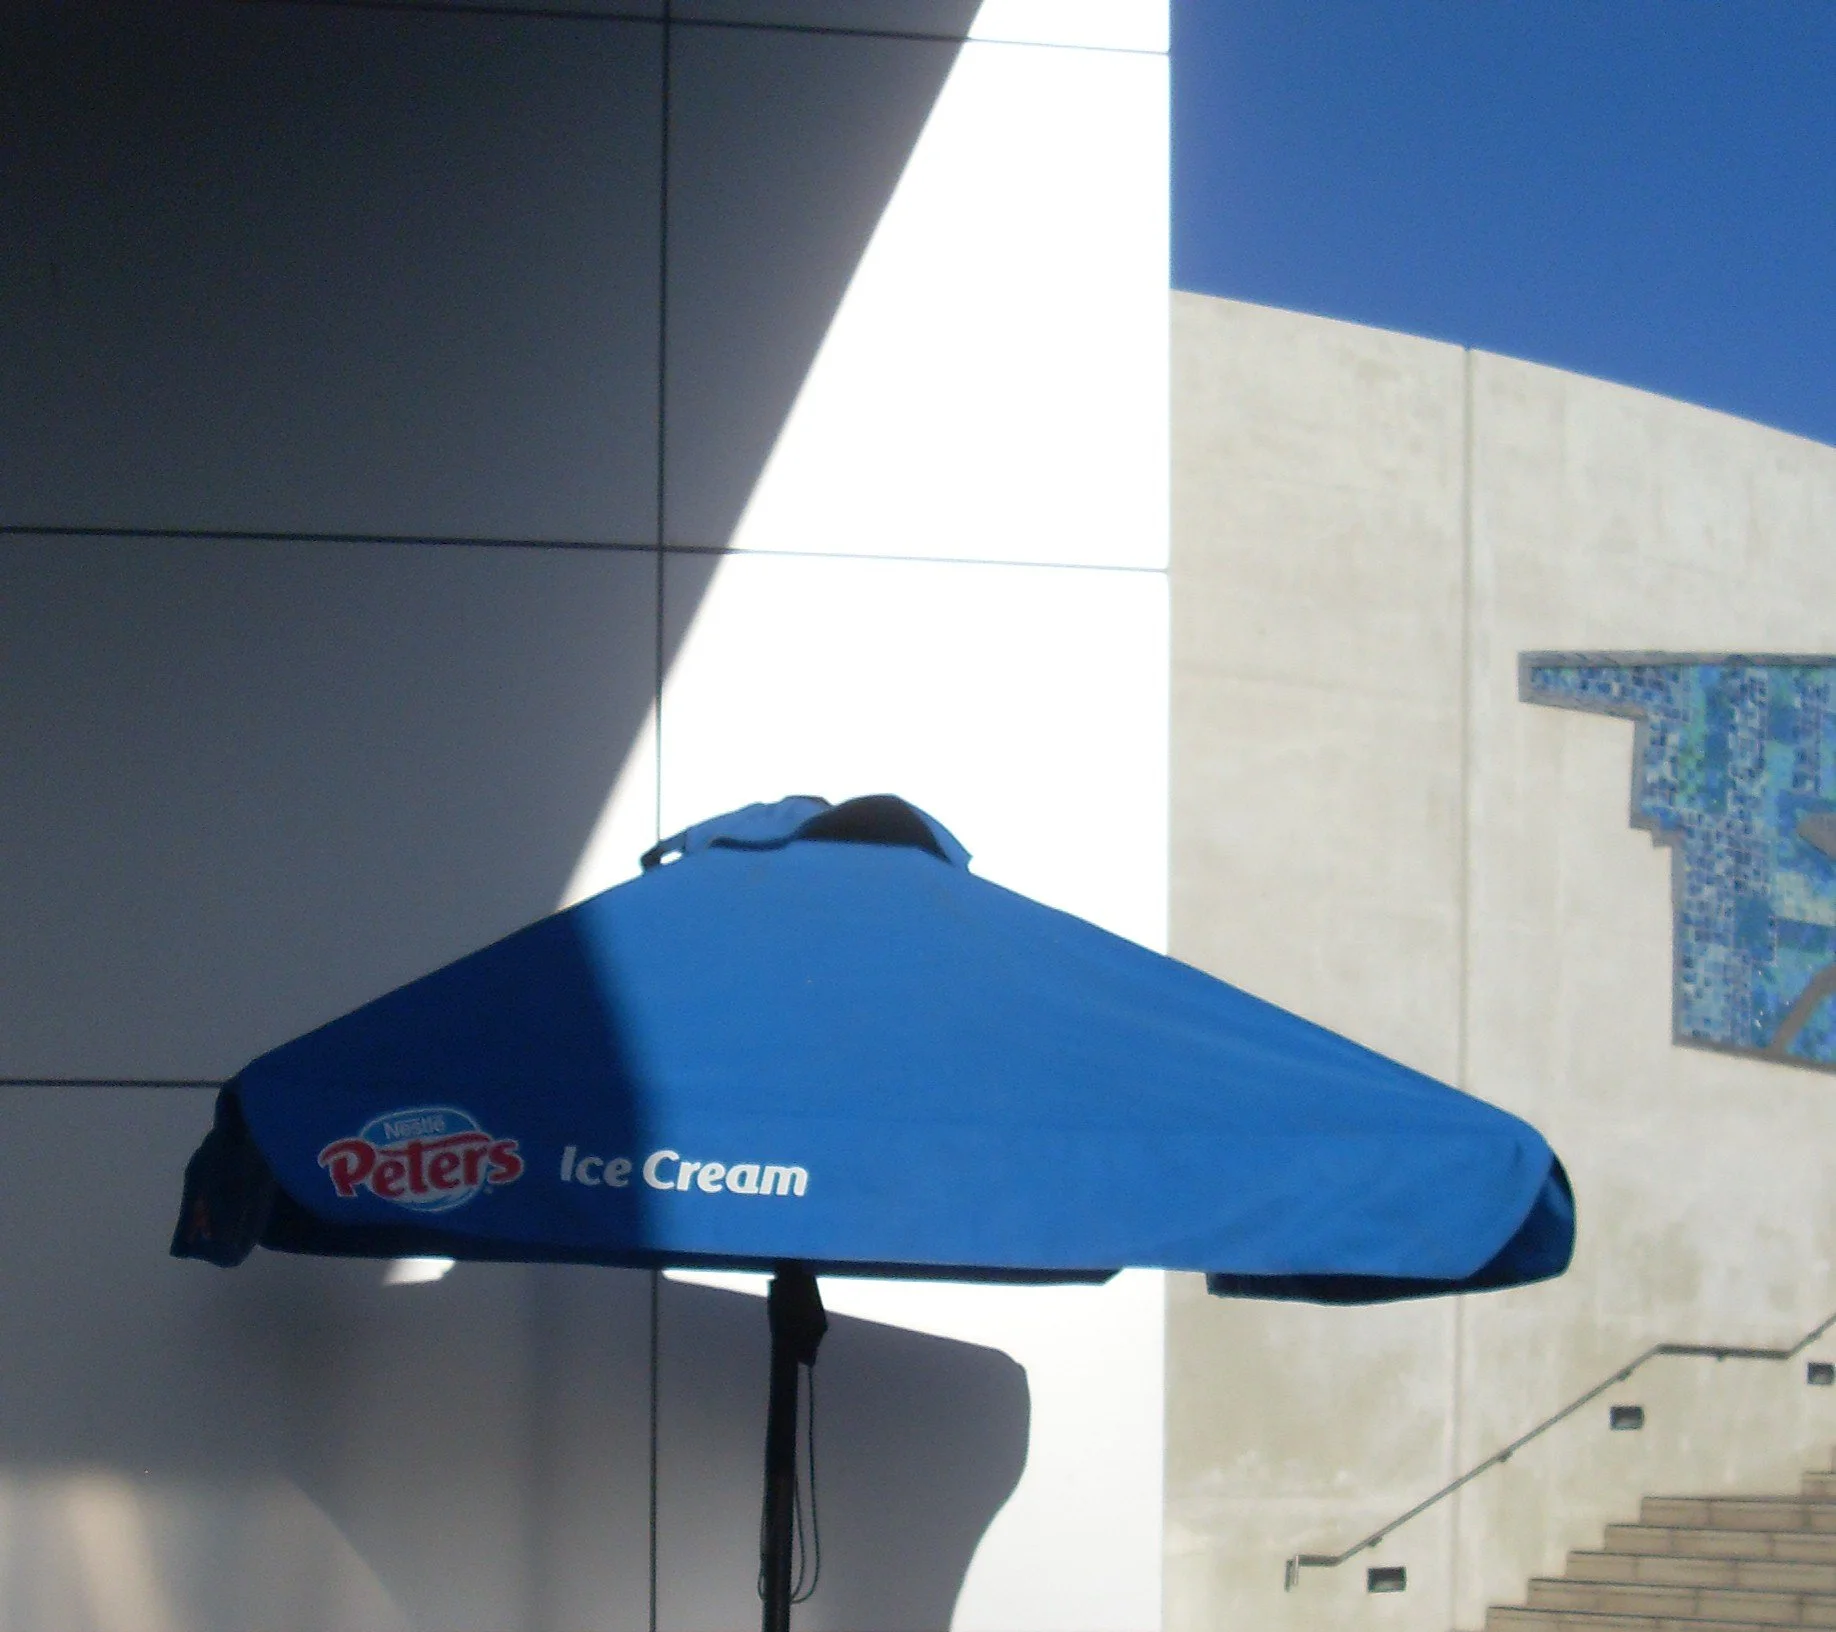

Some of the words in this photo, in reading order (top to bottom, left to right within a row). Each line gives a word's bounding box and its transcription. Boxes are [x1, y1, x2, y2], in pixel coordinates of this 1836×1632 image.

[318, 1134, 524, 1197] Peters
[560, 1146, 631, 1187] Ice
[643, 1149, 809, 1197] Cream
